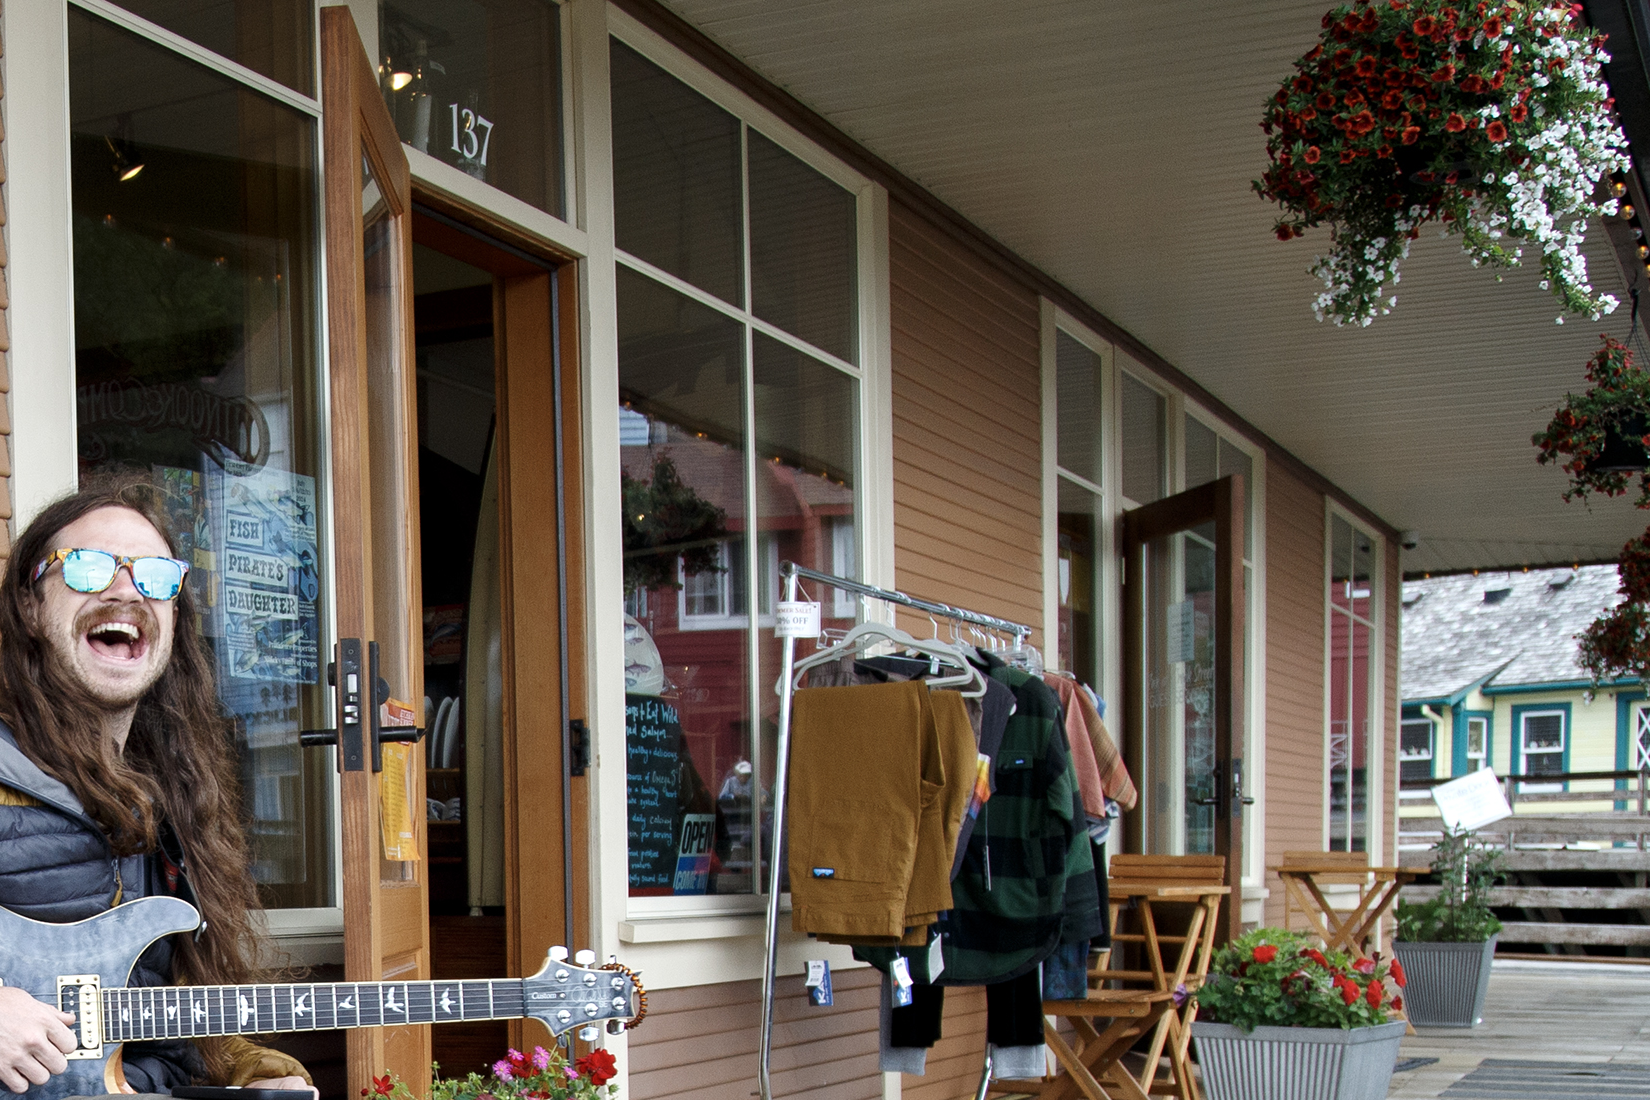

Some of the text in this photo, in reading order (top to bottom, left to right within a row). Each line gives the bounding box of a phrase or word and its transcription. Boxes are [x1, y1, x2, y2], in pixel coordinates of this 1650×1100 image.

[449, 103, 494, 166] 137
[230, 519, 259, 539] FISH
[228, 554, 284, 581] PIRATE'S
[228, 590, 296, 614] DAUGHTER
[792, 617, 809, 625] OFF
[681, 820, 715, 854] OPEN
[675, 870, 694, 890] COME
[531, 992, 557, 1000] Custom
